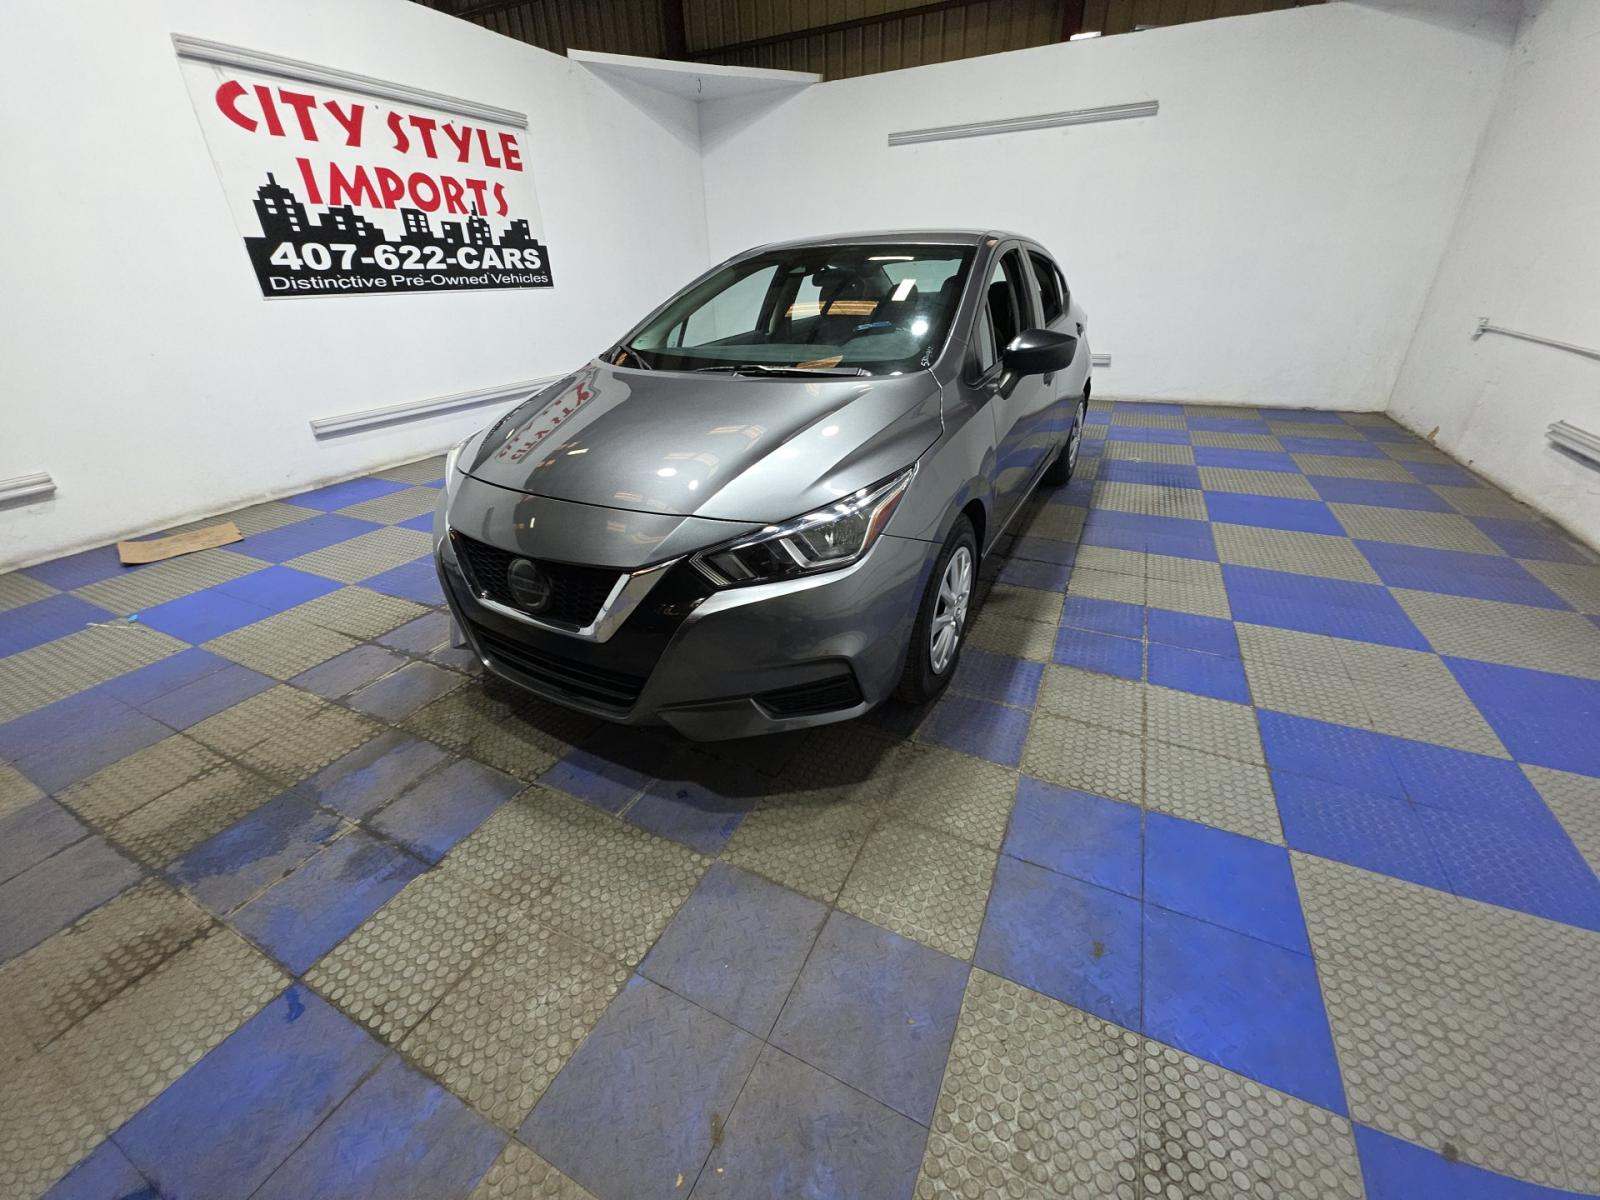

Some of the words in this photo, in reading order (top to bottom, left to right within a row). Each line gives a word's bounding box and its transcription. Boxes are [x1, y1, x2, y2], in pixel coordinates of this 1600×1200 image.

[215, 79, 365, 147] CITY
[387, 111, 523, 172] STYLE
[295, 157, 508, 217] IMPORTS
[269, 242, 541, 270] 407-622-CARS
[269, 275, 387, 290] Distinctive
[391, 274, 488, 287] Pre-Owned
[491, 273, 549, 284] Vehicles
